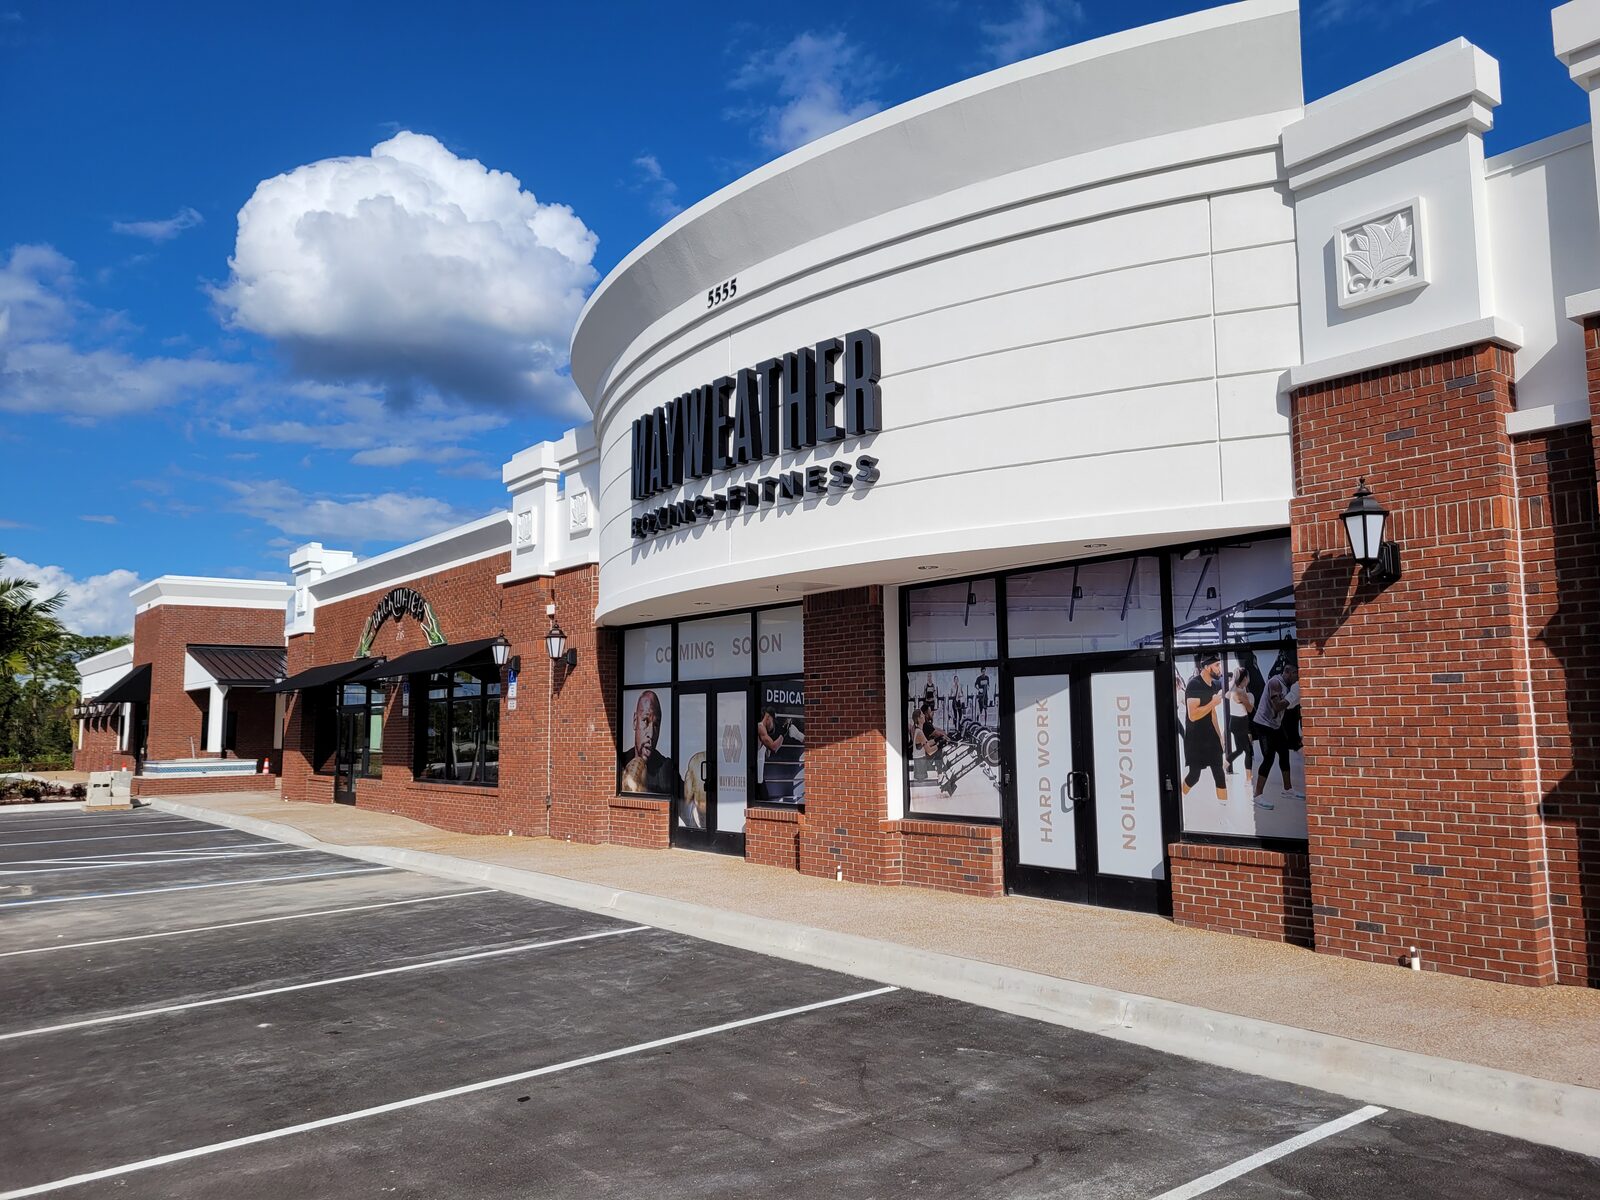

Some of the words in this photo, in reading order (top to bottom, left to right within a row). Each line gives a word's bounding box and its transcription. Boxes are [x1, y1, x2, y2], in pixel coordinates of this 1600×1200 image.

[707, 277, 737, 309] 5555
[631, 328, 883, 500] MAYWEATHER
[655, 640, 715, 664] COMING
[732, 633, 782, 656] SOON
[1036, 697, 1051, 769] WORK
[1116, 696, 1137, 850] DEDICATION
[1039, 776, 1053, 843] HARD
